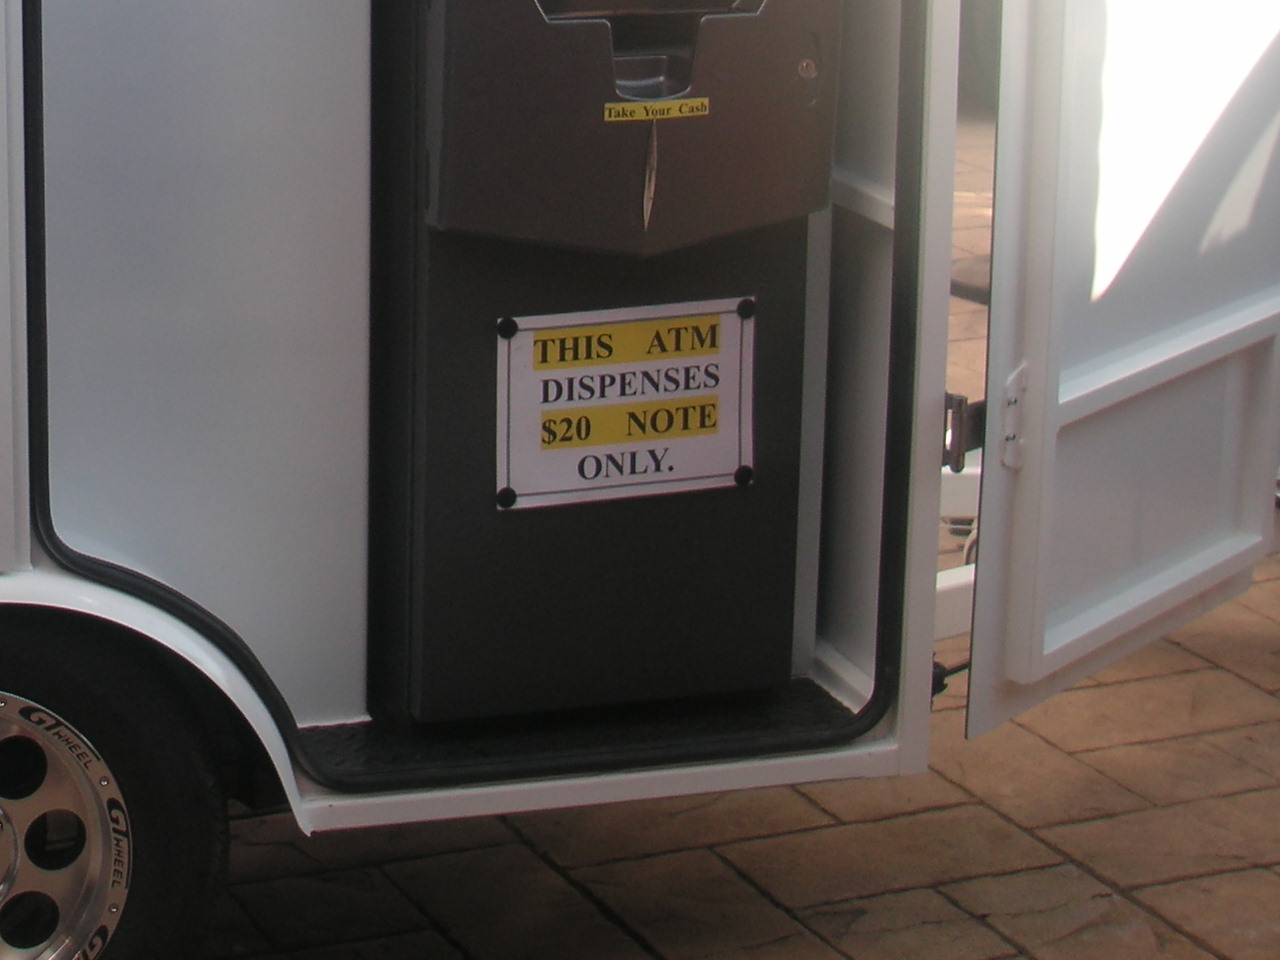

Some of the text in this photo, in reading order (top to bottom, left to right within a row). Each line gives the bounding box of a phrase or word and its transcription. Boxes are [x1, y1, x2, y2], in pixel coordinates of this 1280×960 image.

[605, 102, 708, 119] Take Your Cash
[533, 324, 719, 364] THIS ATM
[540, 364, 719, 403] DISPENSES
[541, 403, 717, 445] $20 NOTE
[577, 448, 674, 480] ONLY.
